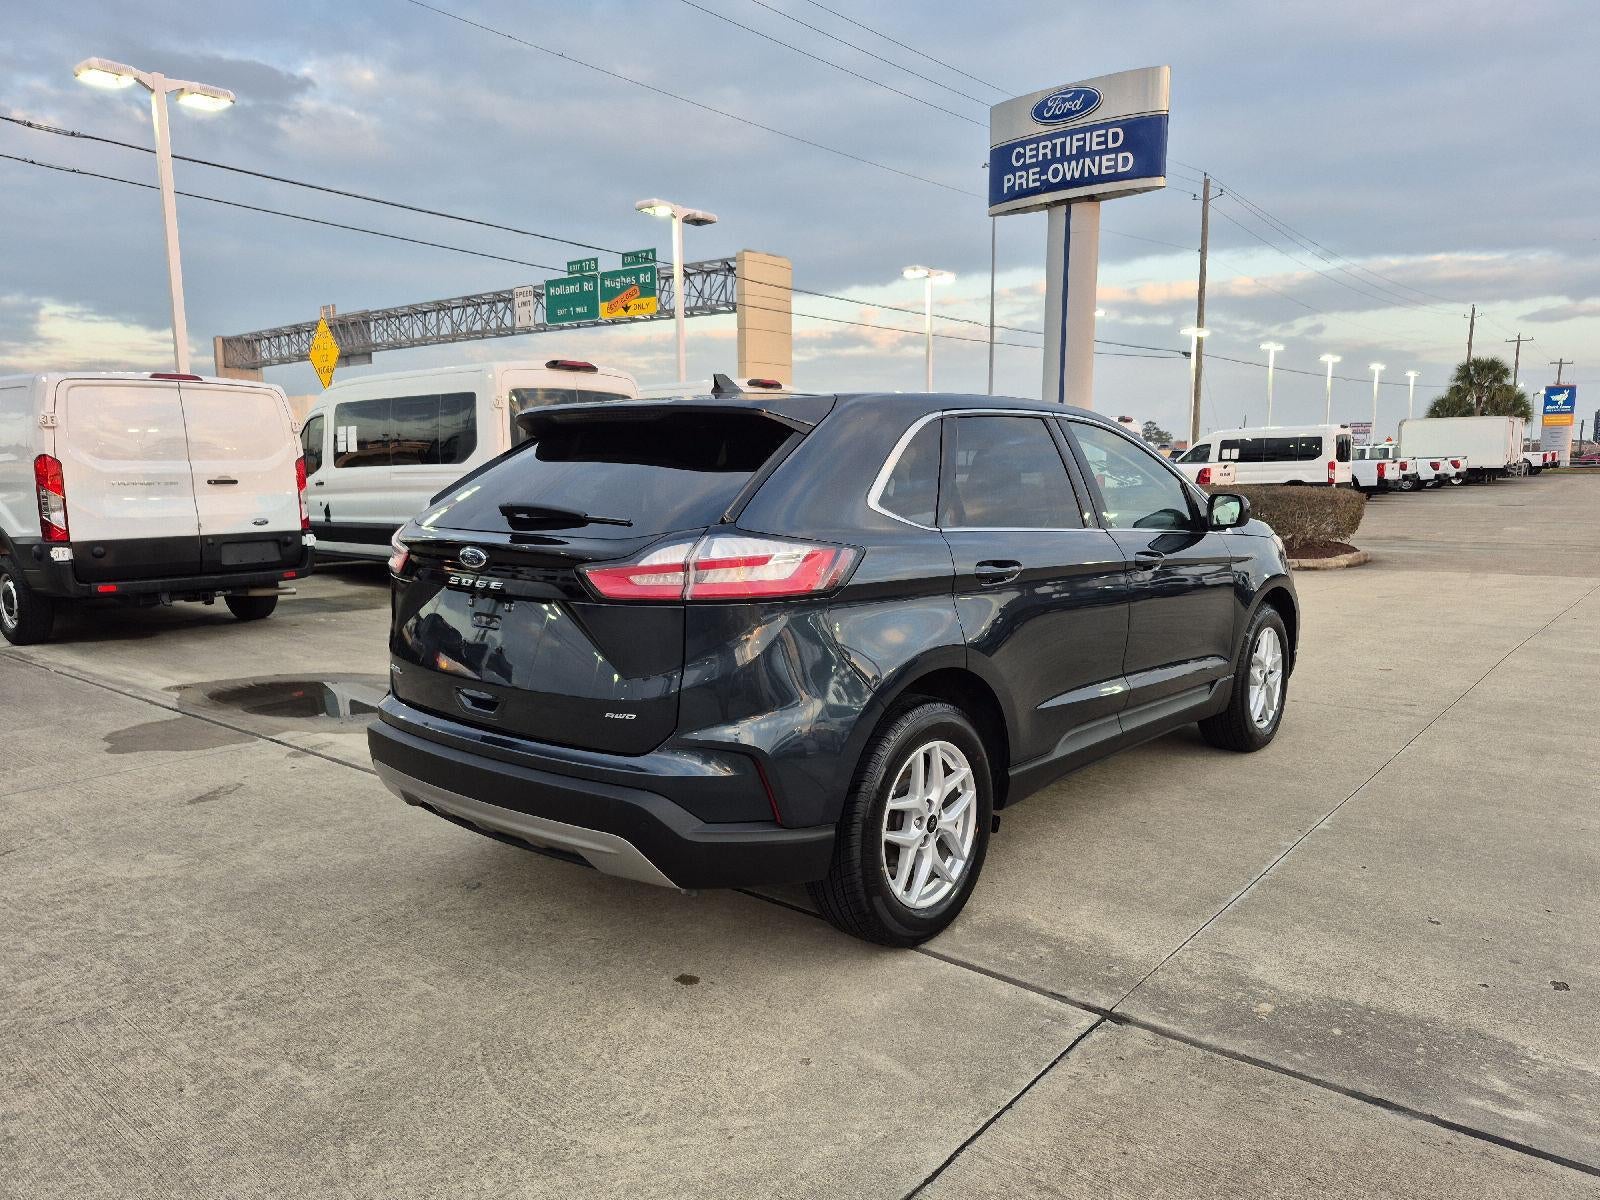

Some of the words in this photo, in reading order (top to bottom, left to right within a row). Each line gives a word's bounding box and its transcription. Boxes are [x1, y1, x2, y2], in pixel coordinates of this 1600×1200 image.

[1043, 91, 1085, 117] Ford
[1011, 127, 1124, 167] CERTIFIED
[1003, 151, 1134, 194] PRE-OWNED
[569, 264, 580, 272] EXIT
[604, 277, 636, 289] Hughes
[639, 271, 651, 284] Rd
[515, 290, 533, 299] SPEED
[550, 284, 580, 297] Holland
[583, 281, 594, 292] Rd
[517, 300, 531, 308] LIMIT
[633, 302, 650, 311] ONLY
[570, 307, 574, 316] 1
[575, 305, 588, 314] MILE
[448, 576, 504, 590] EDGE
[604, 712, 637, 720] AWD
